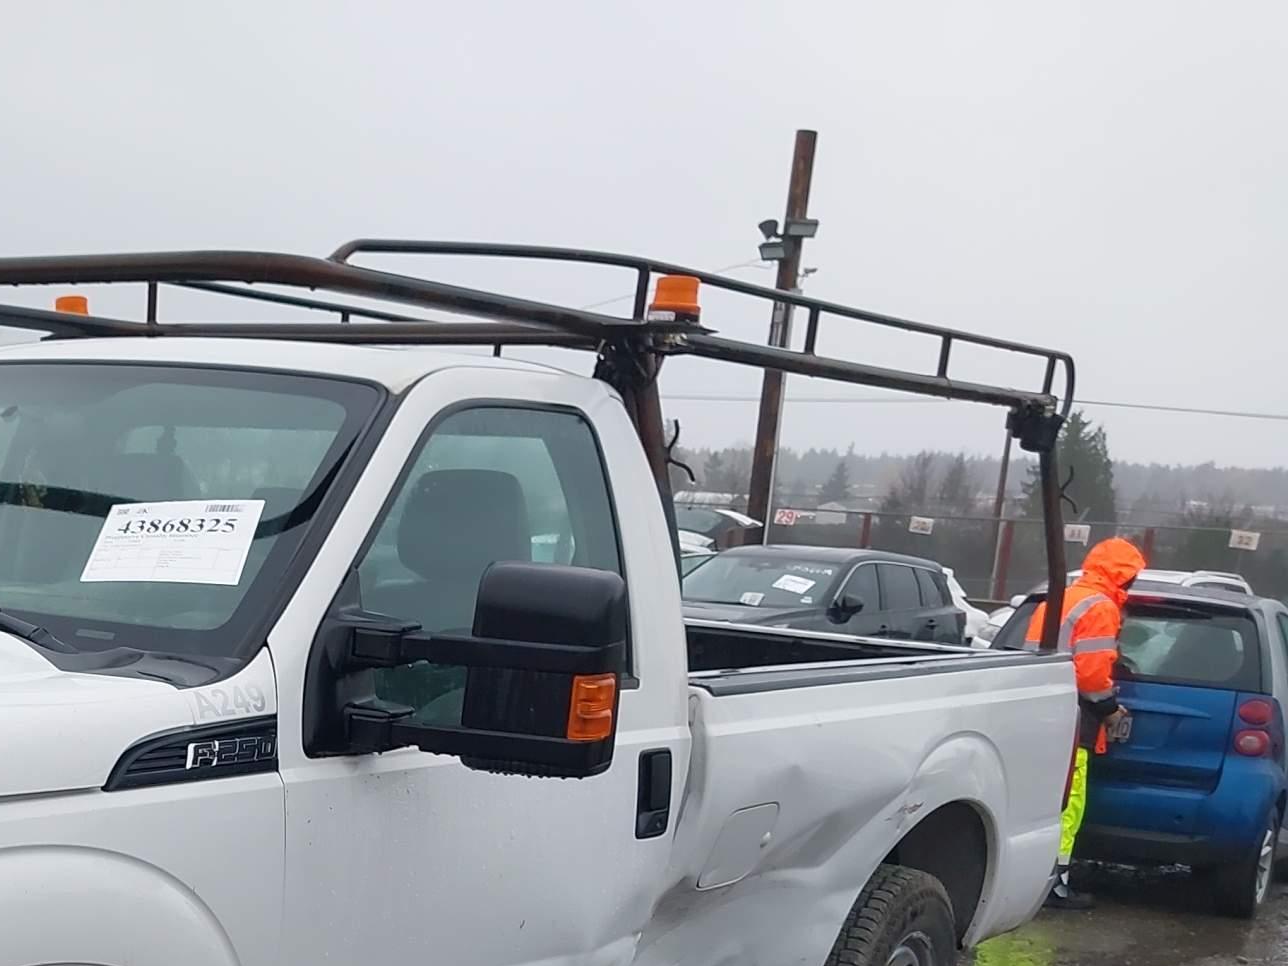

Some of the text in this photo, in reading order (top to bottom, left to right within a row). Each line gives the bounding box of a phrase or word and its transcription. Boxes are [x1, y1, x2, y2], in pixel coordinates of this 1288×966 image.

[777, 510, 794, 524] 29
[117, 518, 238, 534] 43868325
[195, 684, 266, 720] A249
